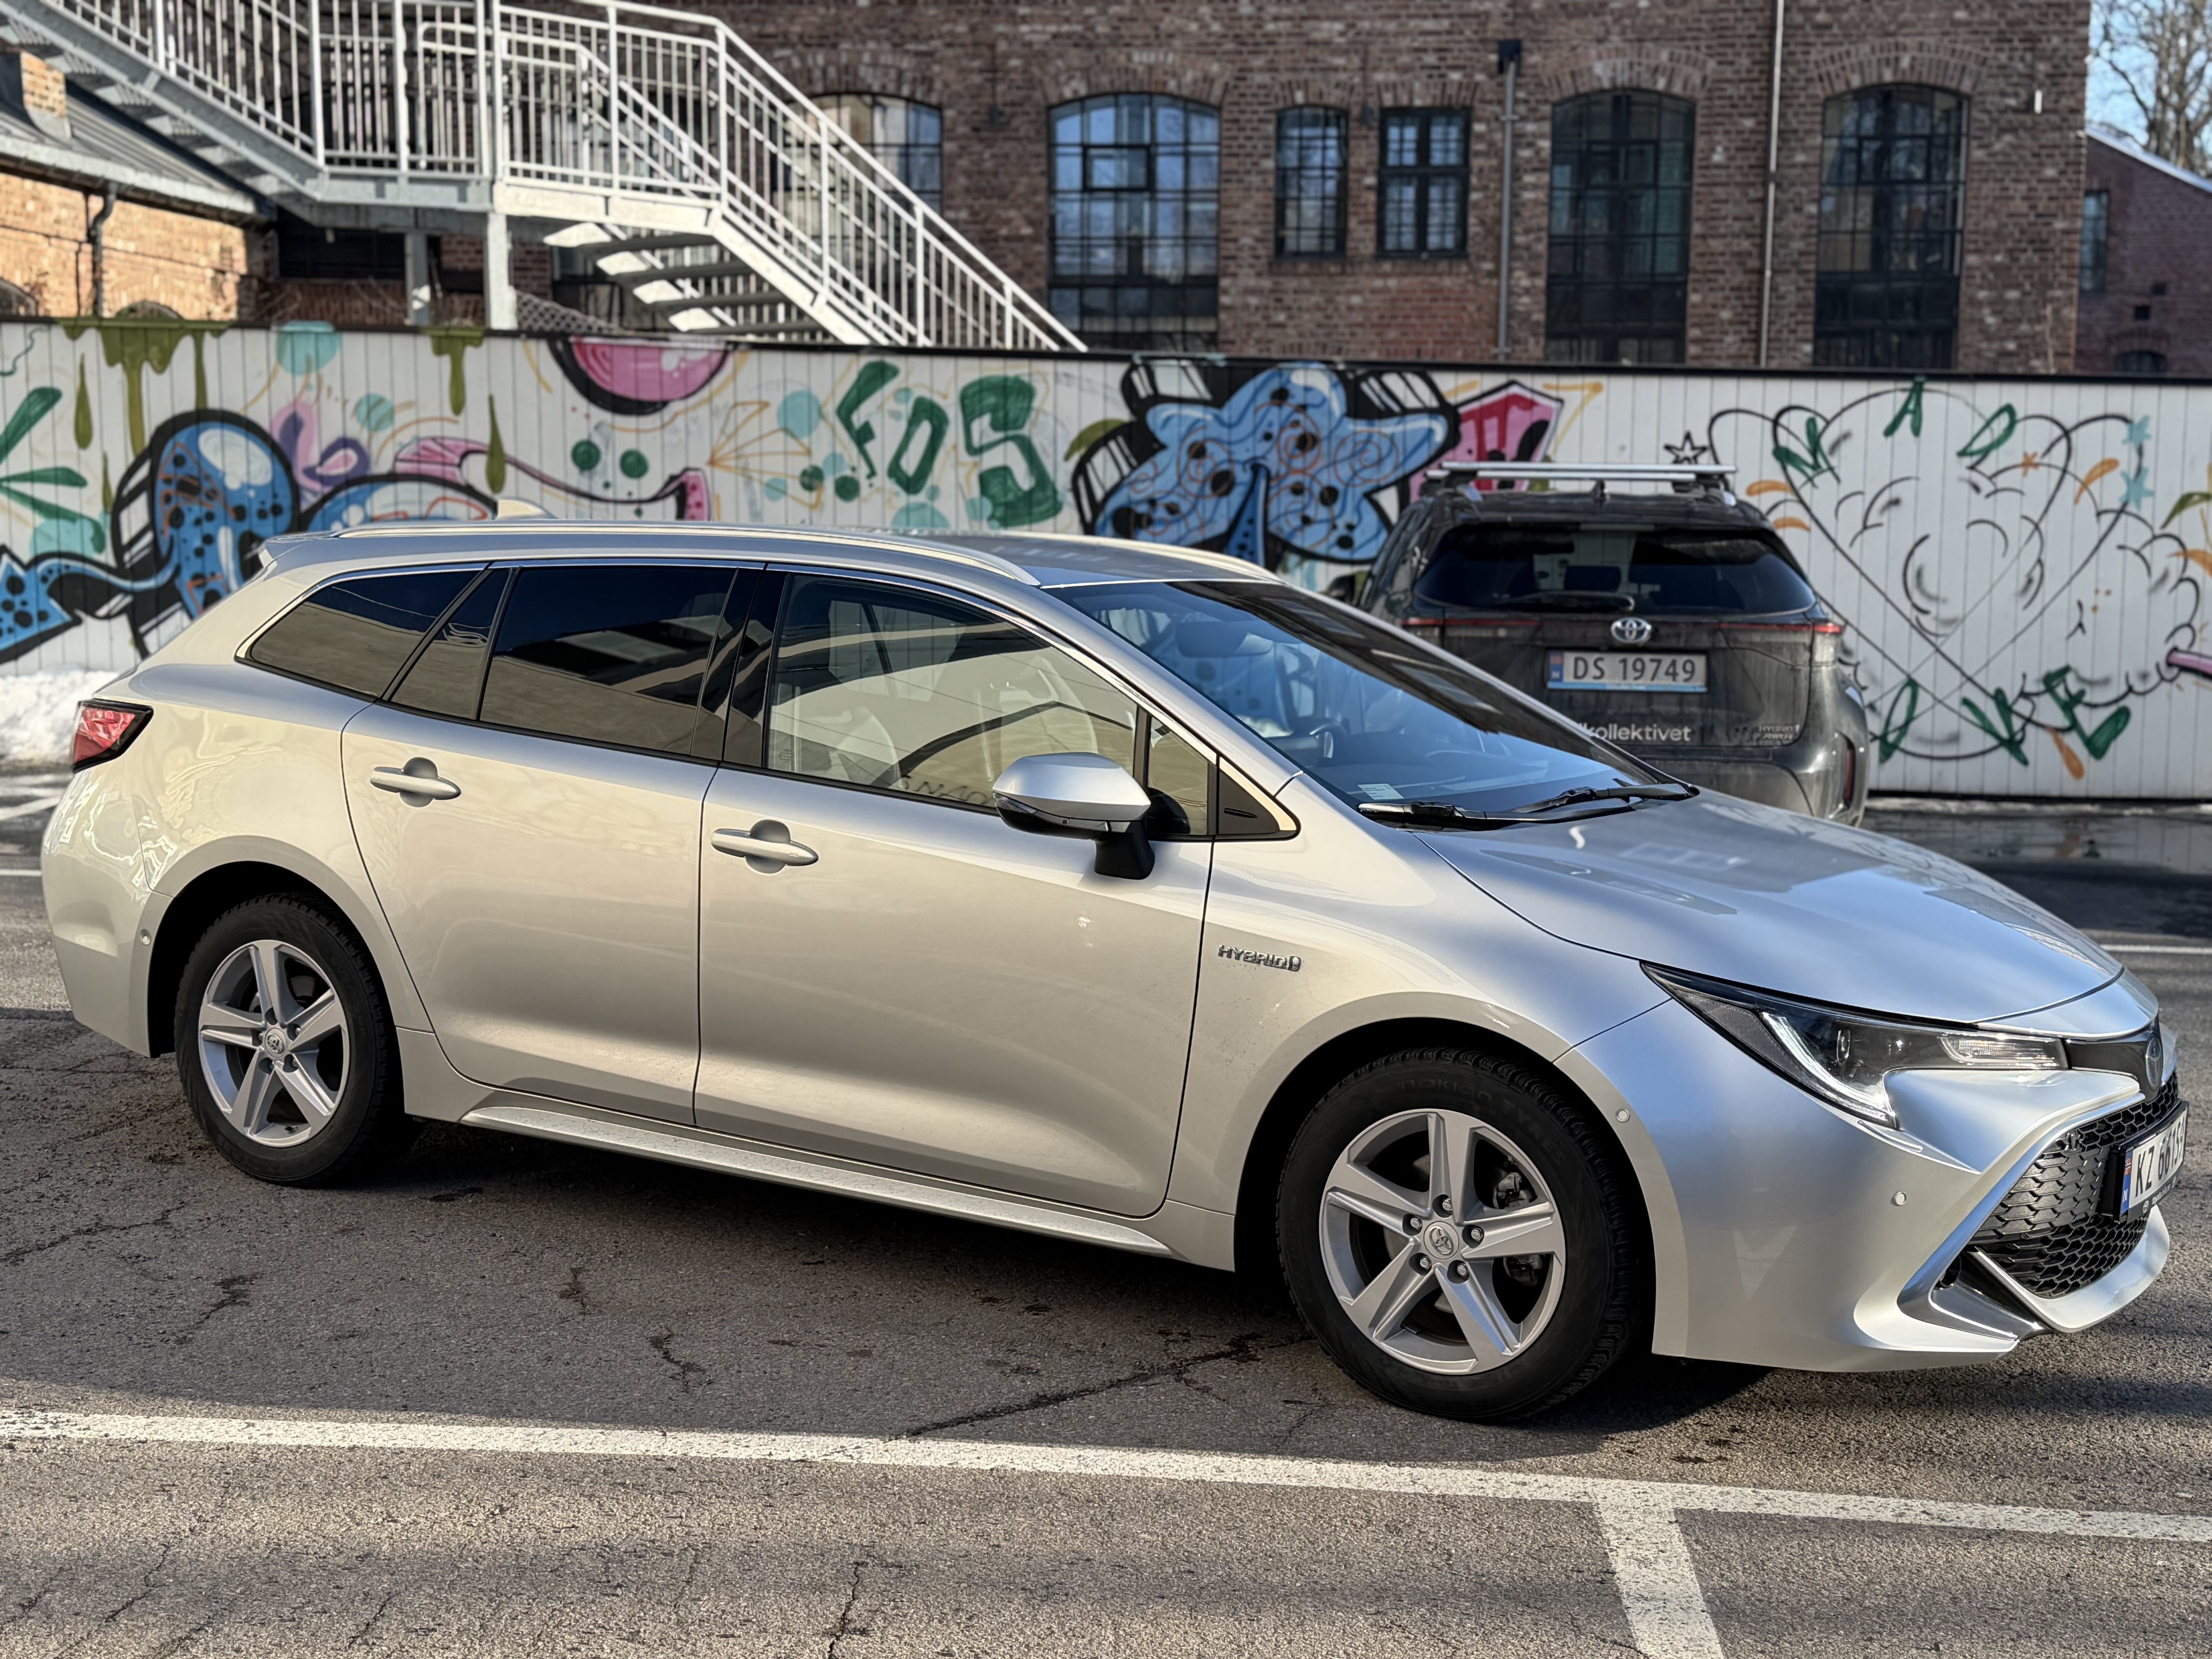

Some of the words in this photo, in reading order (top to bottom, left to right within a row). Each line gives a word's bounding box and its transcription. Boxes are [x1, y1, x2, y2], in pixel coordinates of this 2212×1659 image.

[1573, 656, 1605, 680] DS
[1618, 658, 1695, 682] 19749
[1579, 722, 1691, 742] ollektivet
[1218, 944, 1288, 970] HYBRID
[2135, 1145, 2155, 1198] KZ
